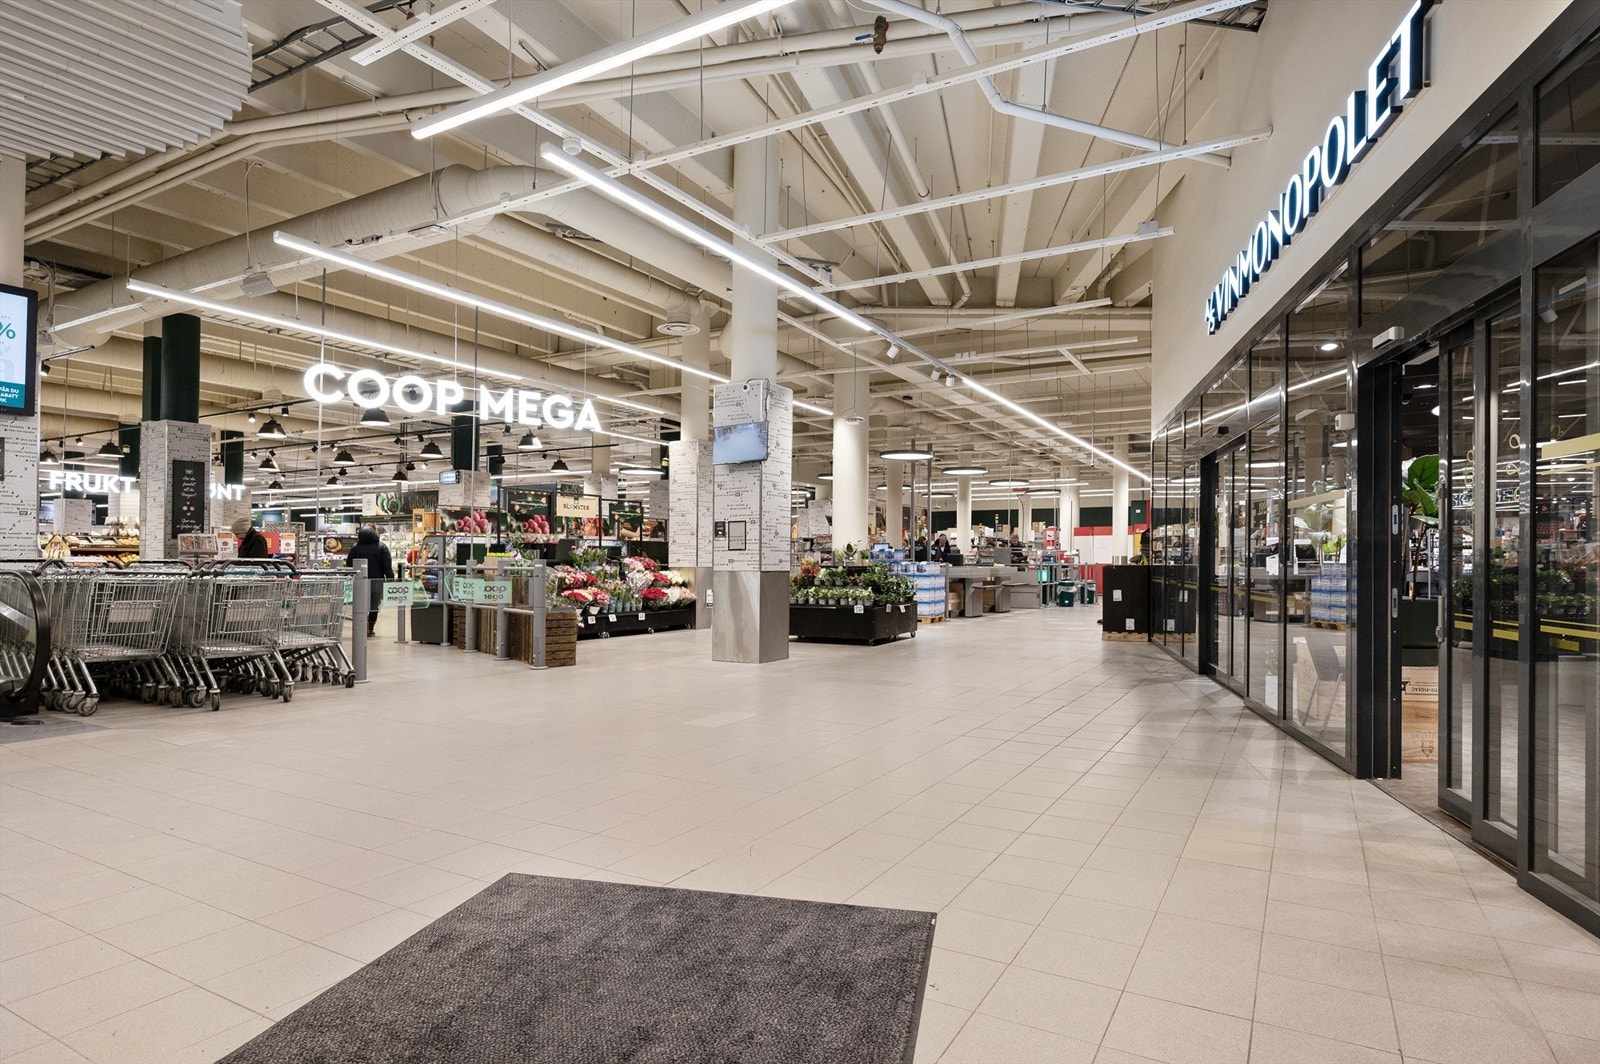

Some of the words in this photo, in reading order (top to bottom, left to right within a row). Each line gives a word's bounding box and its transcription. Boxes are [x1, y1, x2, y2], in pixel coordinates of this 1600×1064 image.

[1215, 0, 1429, 323] VINMONOPOLET
[303, 363, 464, 416] COOP
[479, 384, 602, 432] MEGA
[49, 470, 137, 495] FRUKT
[387, 586, 409, 595] coop
